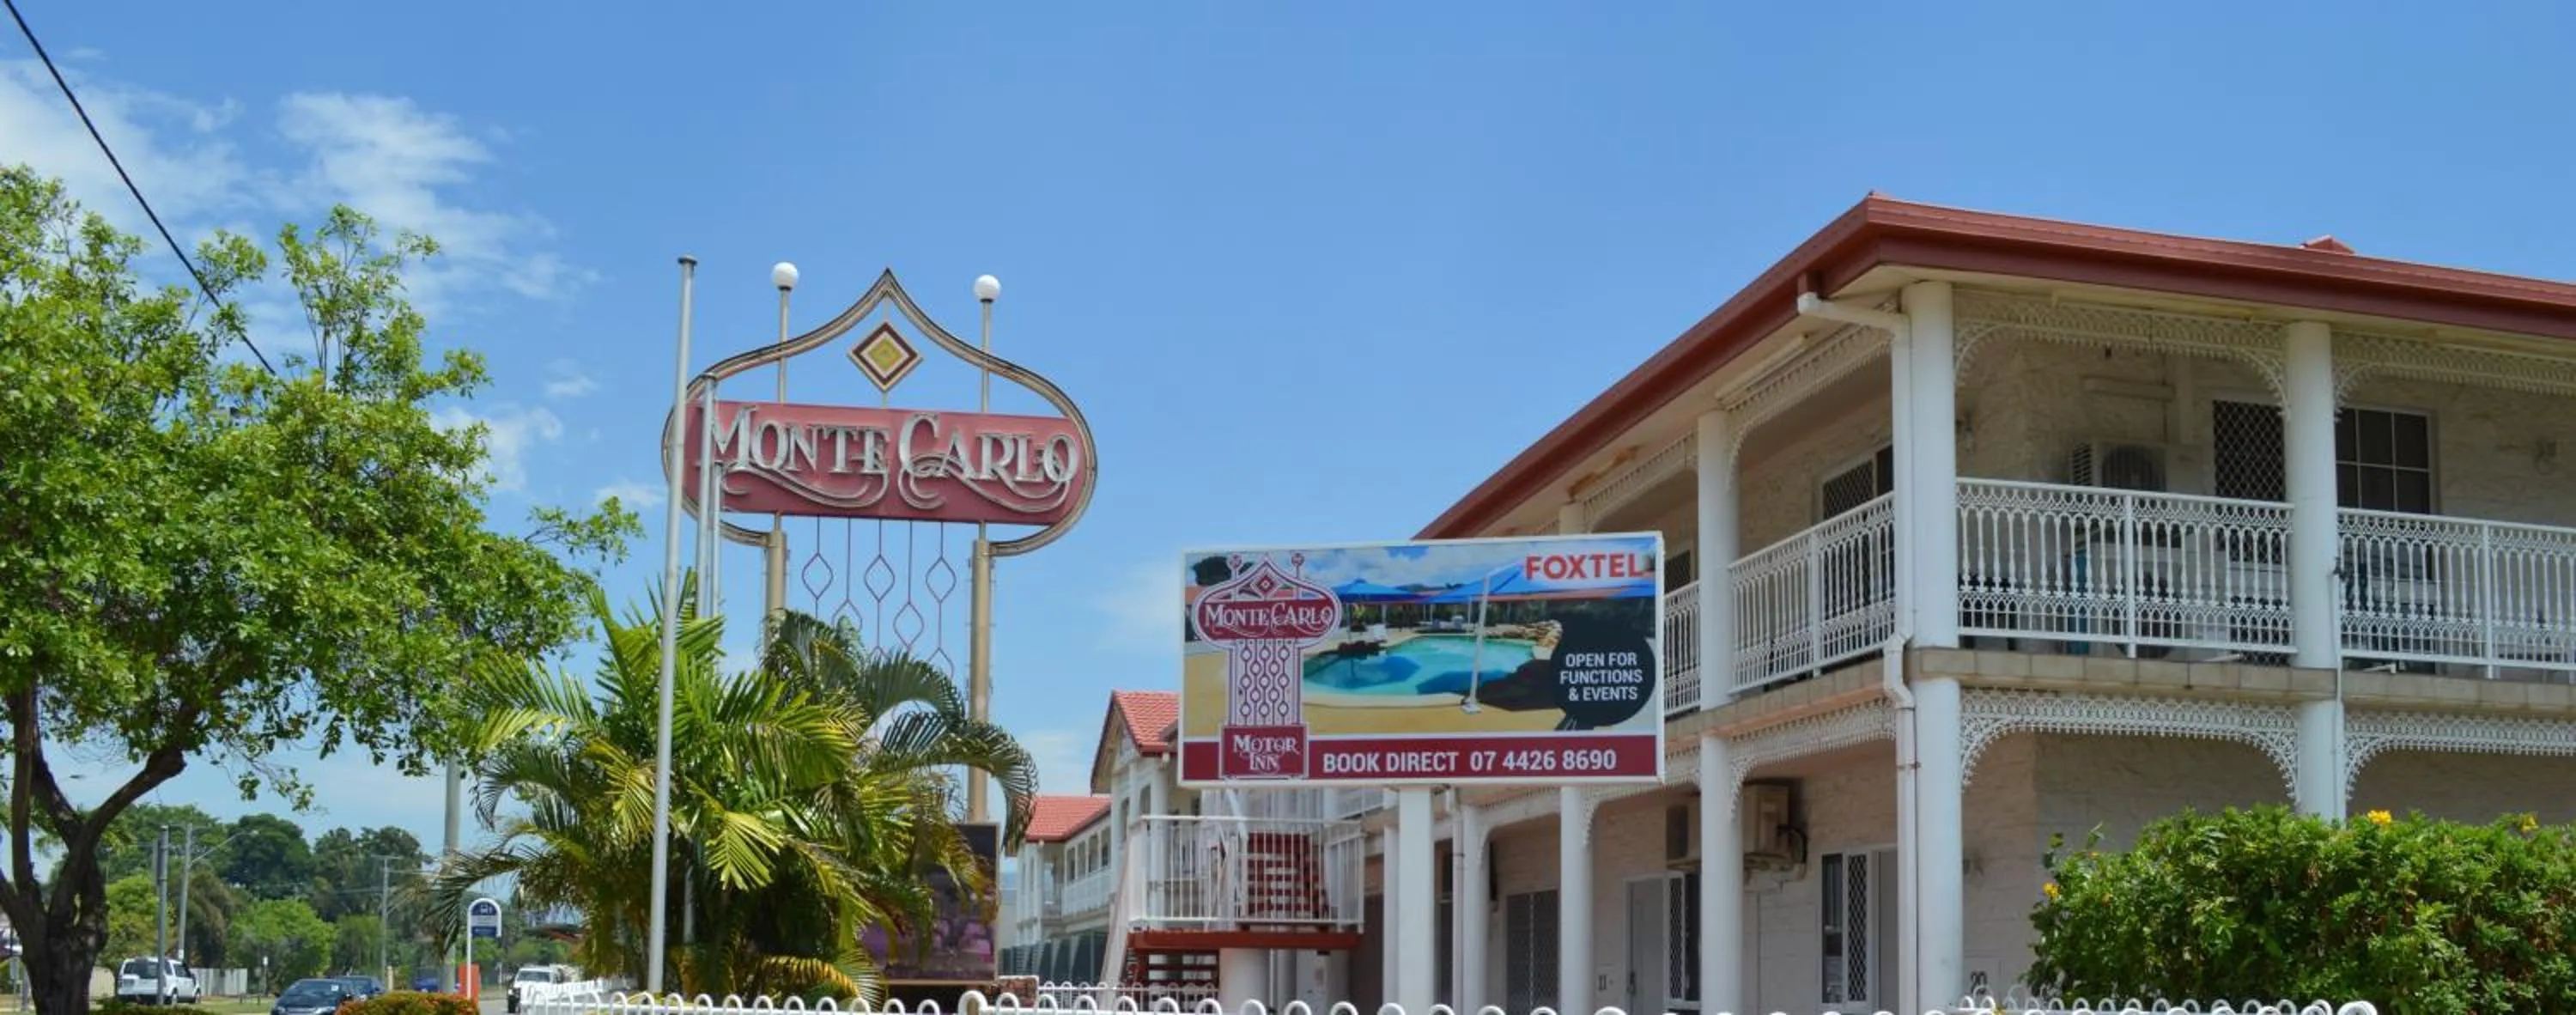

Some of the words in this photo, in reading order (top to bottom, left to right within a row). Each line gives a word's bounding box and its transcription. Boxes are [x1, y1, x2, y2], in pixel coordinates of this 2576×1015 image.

[696, 405, 890, 493] MONTE
[898, 412, 1079, 496] CARLO
[1525, 552, 1643, 580] FOXTEL
[1205, 603, 1270, 629] MONTE
[1270, 602, 1334, 629] CARLO
[1564, 653, 1606, 668] OPEN
[1608, 652, 1638, 666] FOR
[1558, 668, 1643, 685] FUNCTIONS
[1567, 686, 1580, 702] &
[1583, 686, 1639, 702] EVENTS
[1231, 734, 1300, 756] MOTOR
[1249, 752, 1281, 772] INN
[1322, 752, 1381, 773] BOOK
[1386, 751, 1460, 772] DIRECT
[1469, 750, 1498, 772] 07
[1502, 749, 1557, 771] 4426
[1561, 748, 1618, 770] 8690
